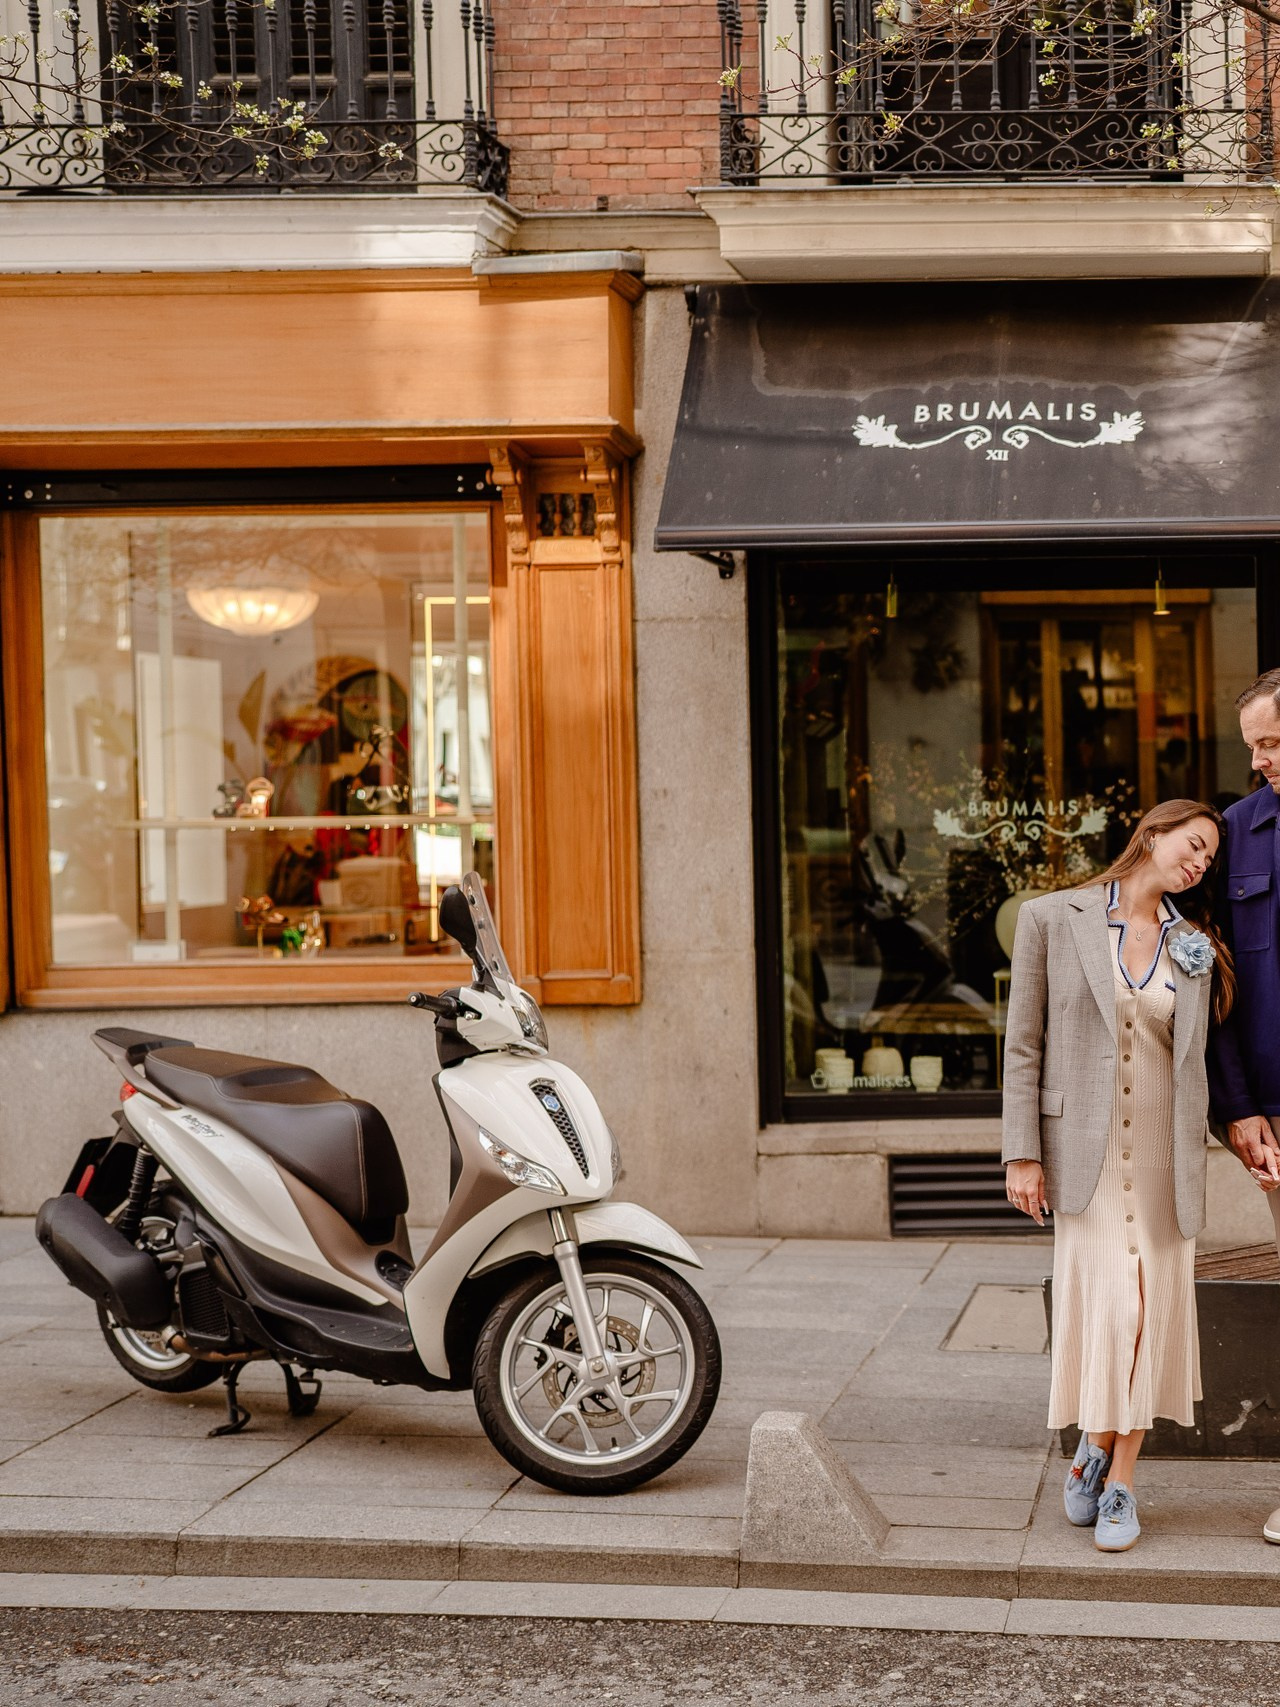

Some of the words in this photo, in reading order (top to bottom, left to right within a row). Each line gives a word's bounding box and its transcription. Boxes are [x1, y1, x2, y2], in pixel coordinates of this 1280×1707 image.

[914, 400, 1097, 423] BRUMALIS
[985, 450, 1009, 461] XII
[968, 800, 1079, 817] BRUMALIS
